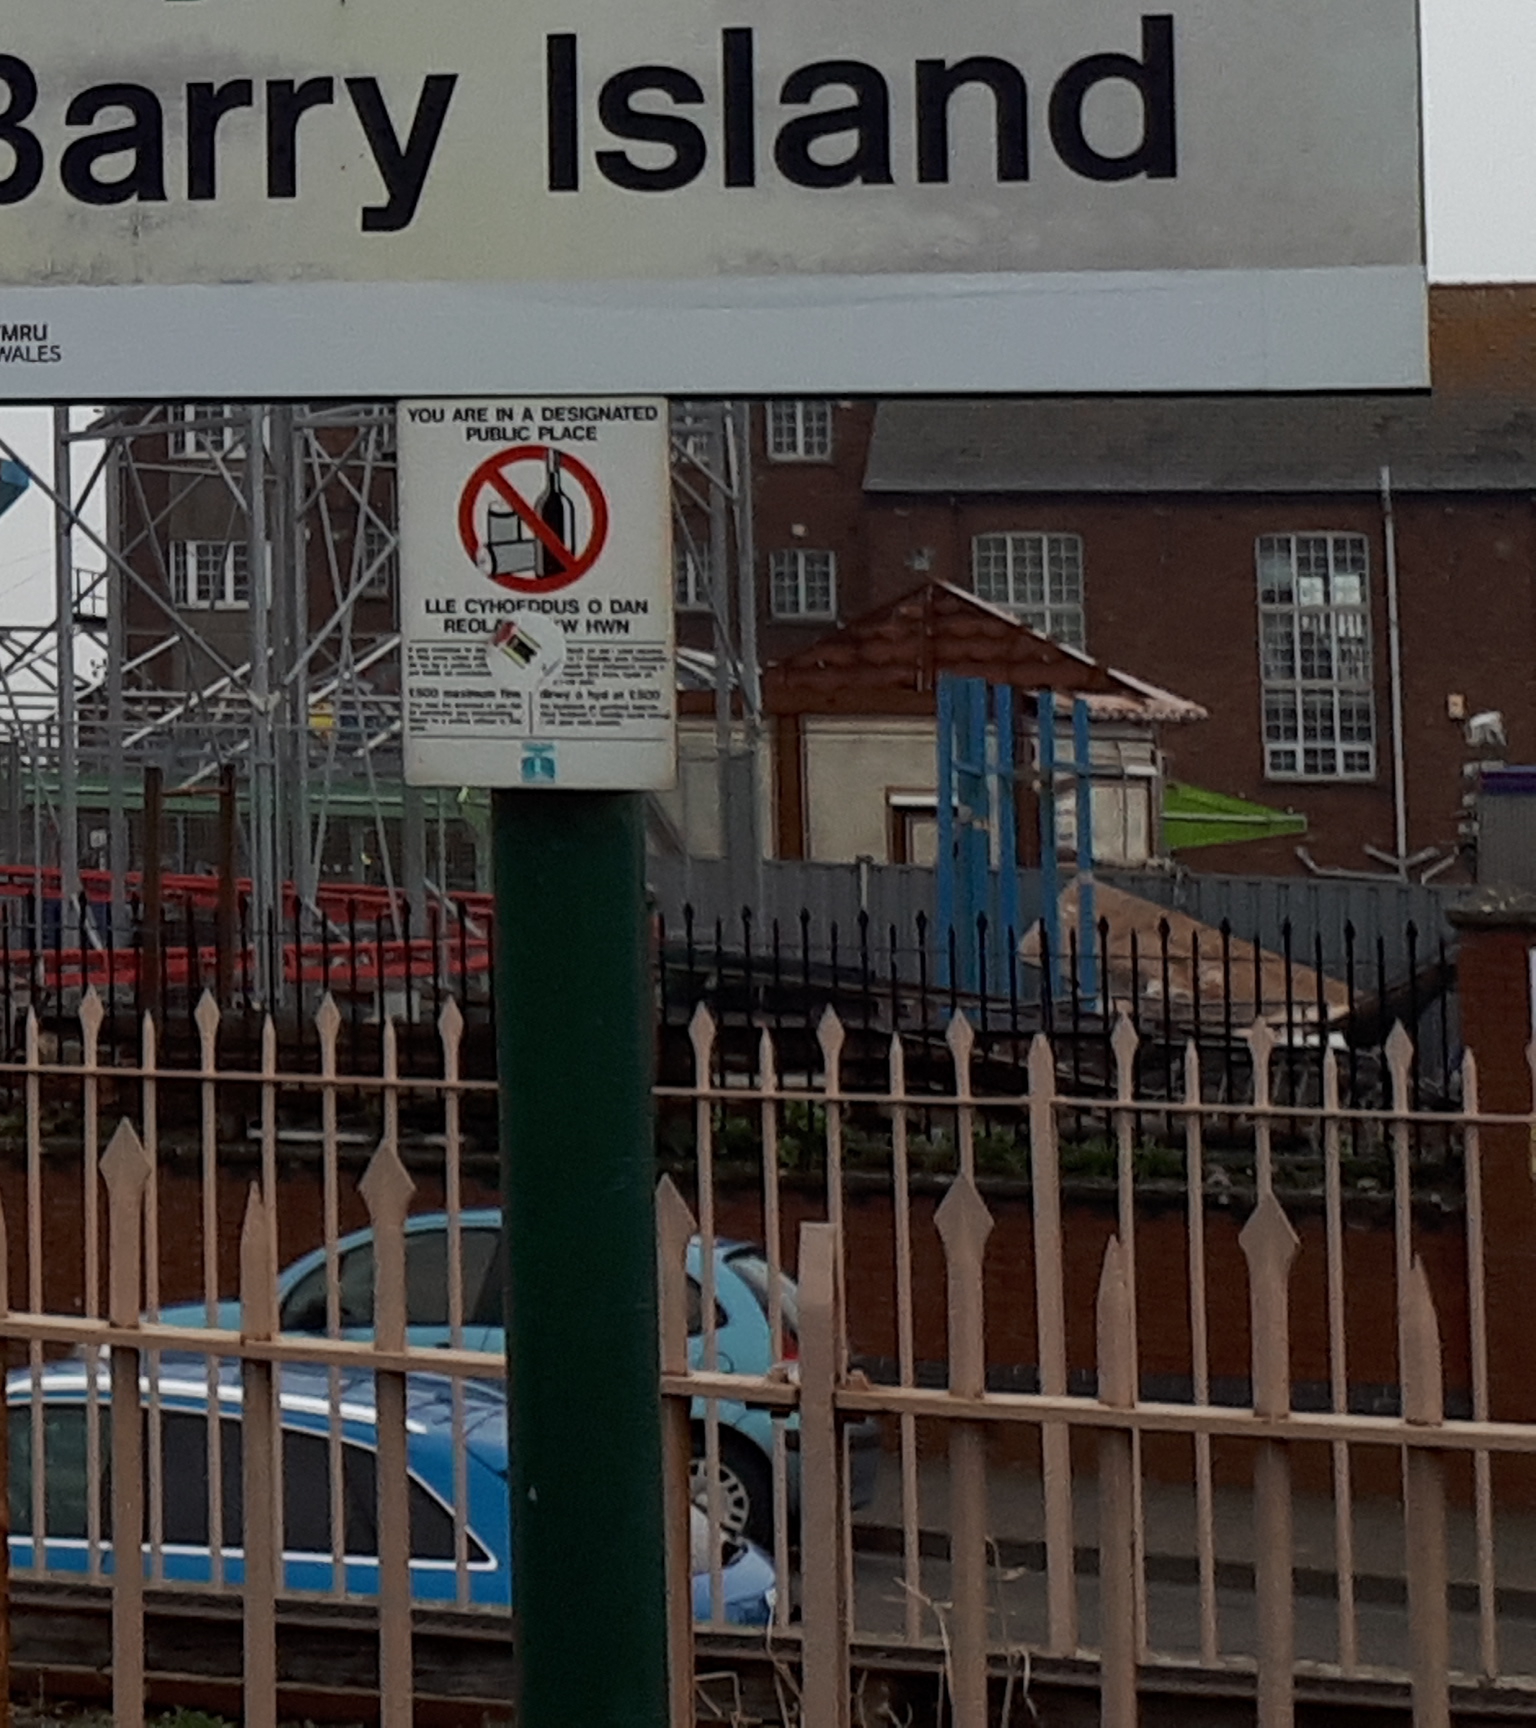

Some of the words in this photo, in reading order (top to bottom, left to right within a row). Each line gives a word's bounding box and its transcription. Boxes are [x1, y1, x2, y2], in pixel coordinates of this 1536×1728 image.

[545, 12, 1179, 194] Island
[407, 407, 446, 424] YOU
[451, 406, 488, 423] ARE
[495, 406, 514, 422] IN
[521, 406, 534, 422] A
[541, 404, 659, 422] DESIGNATED
[465, 425, 531, 442] PUBLIC
[538, 424, 598, 441] PLACE
[425, 598, 457, 614] LLE
[464, 597, 580, 614] CYHOEDDUS
[587, 597, 603, 614] O
[609, 598, 649, 614] DAN
[585, 619, 631, 635] HWN
